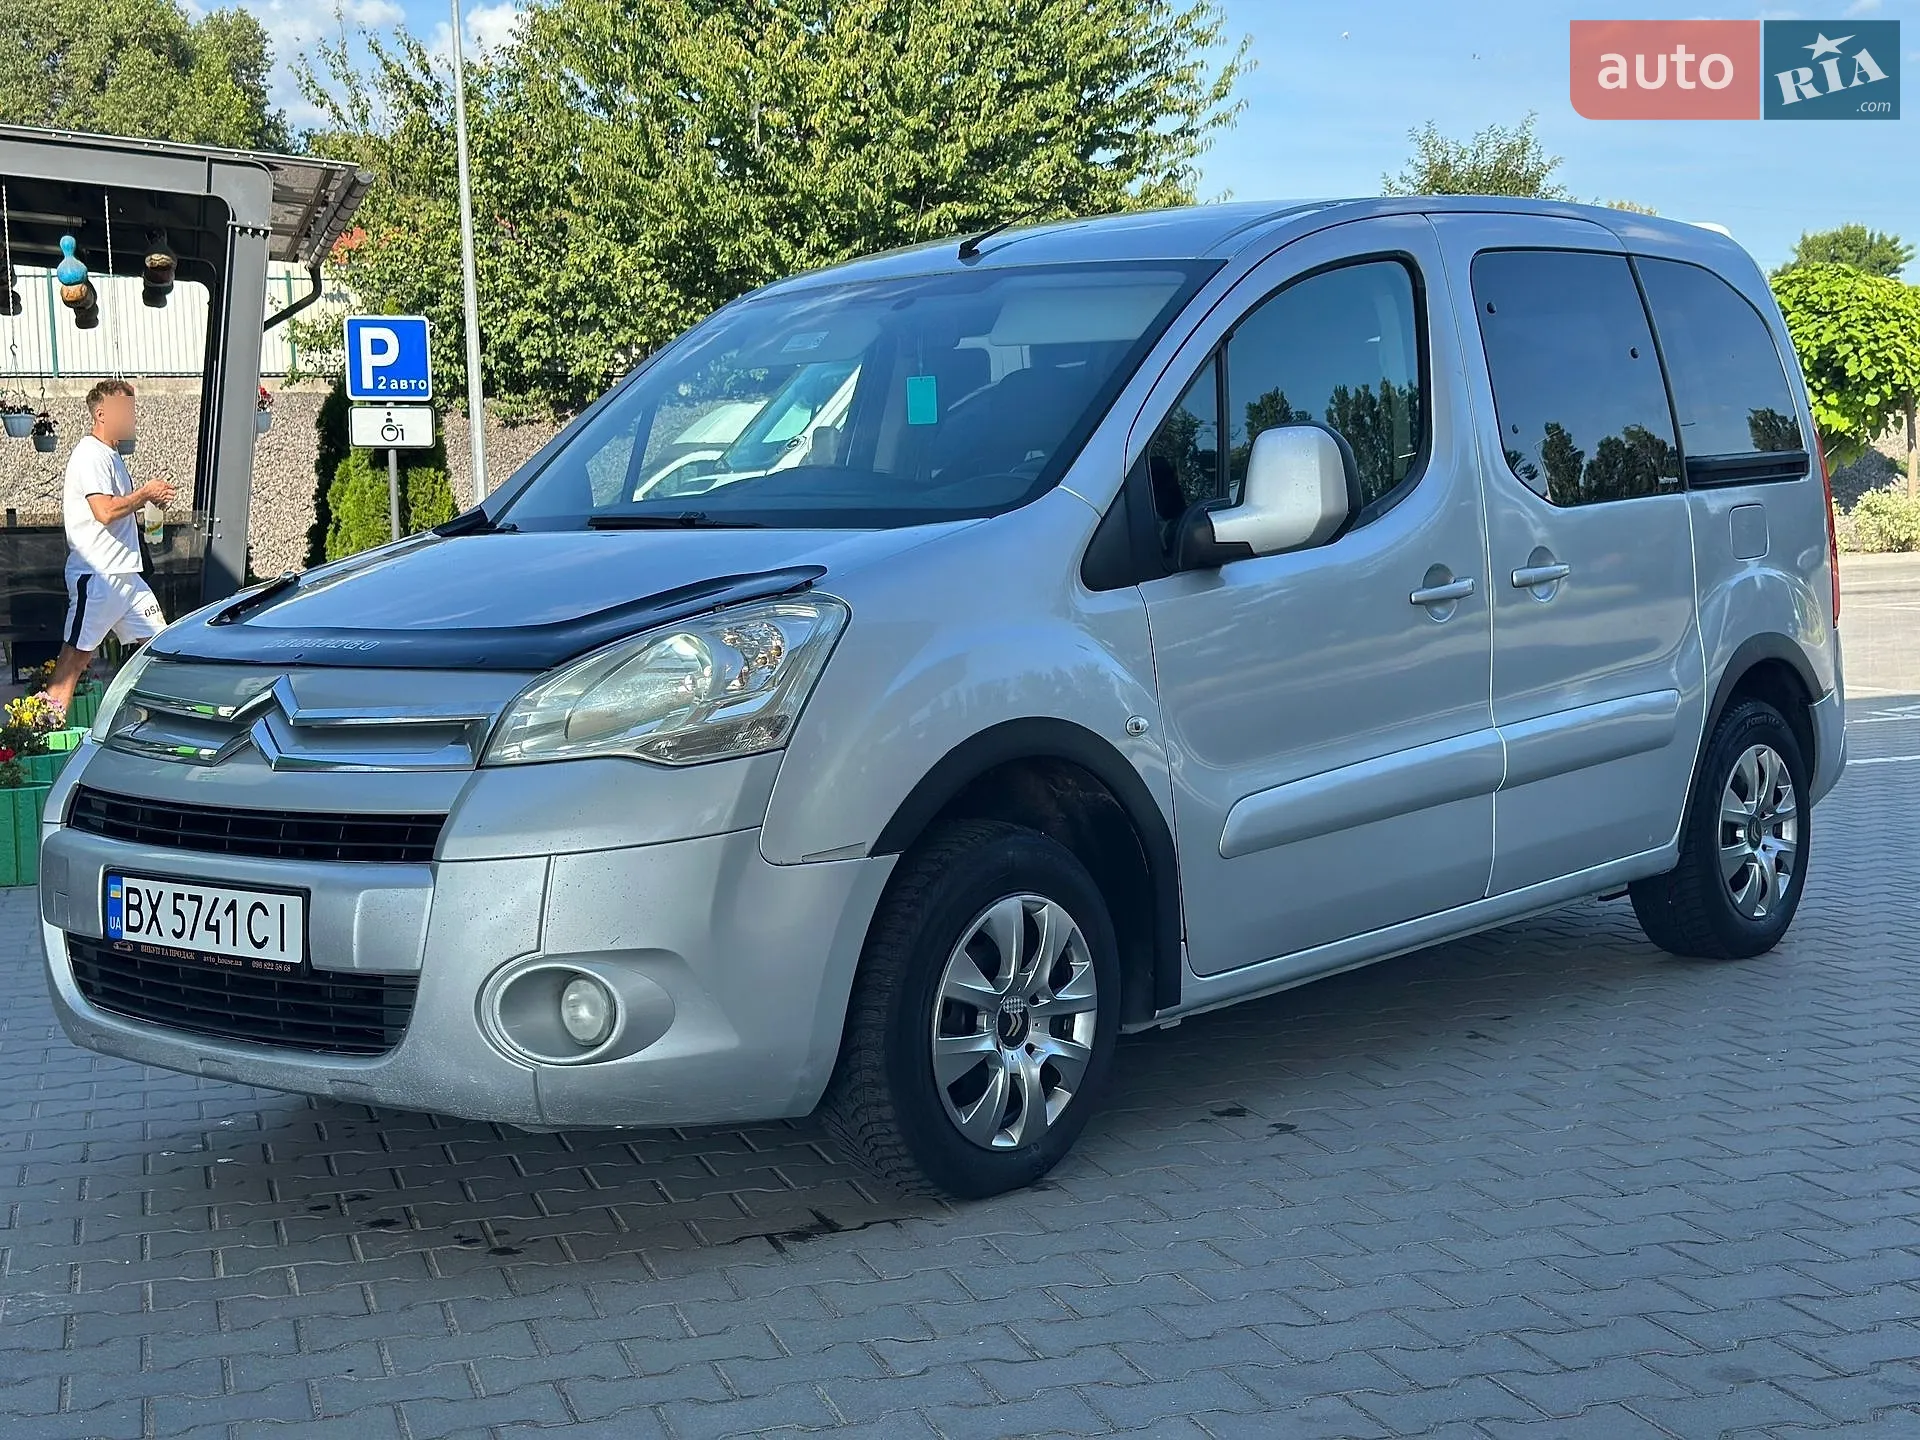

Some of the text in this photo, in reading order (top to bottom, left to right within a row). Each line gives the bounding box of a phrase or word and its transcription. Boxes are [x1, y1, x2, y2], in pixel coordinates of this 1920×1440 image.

[360, 327, 400, 390] P
[377, 376, 428, 390] 2 авто
[109, 915, 122, 931] UA
[171, 892, 238, 947] 5741
